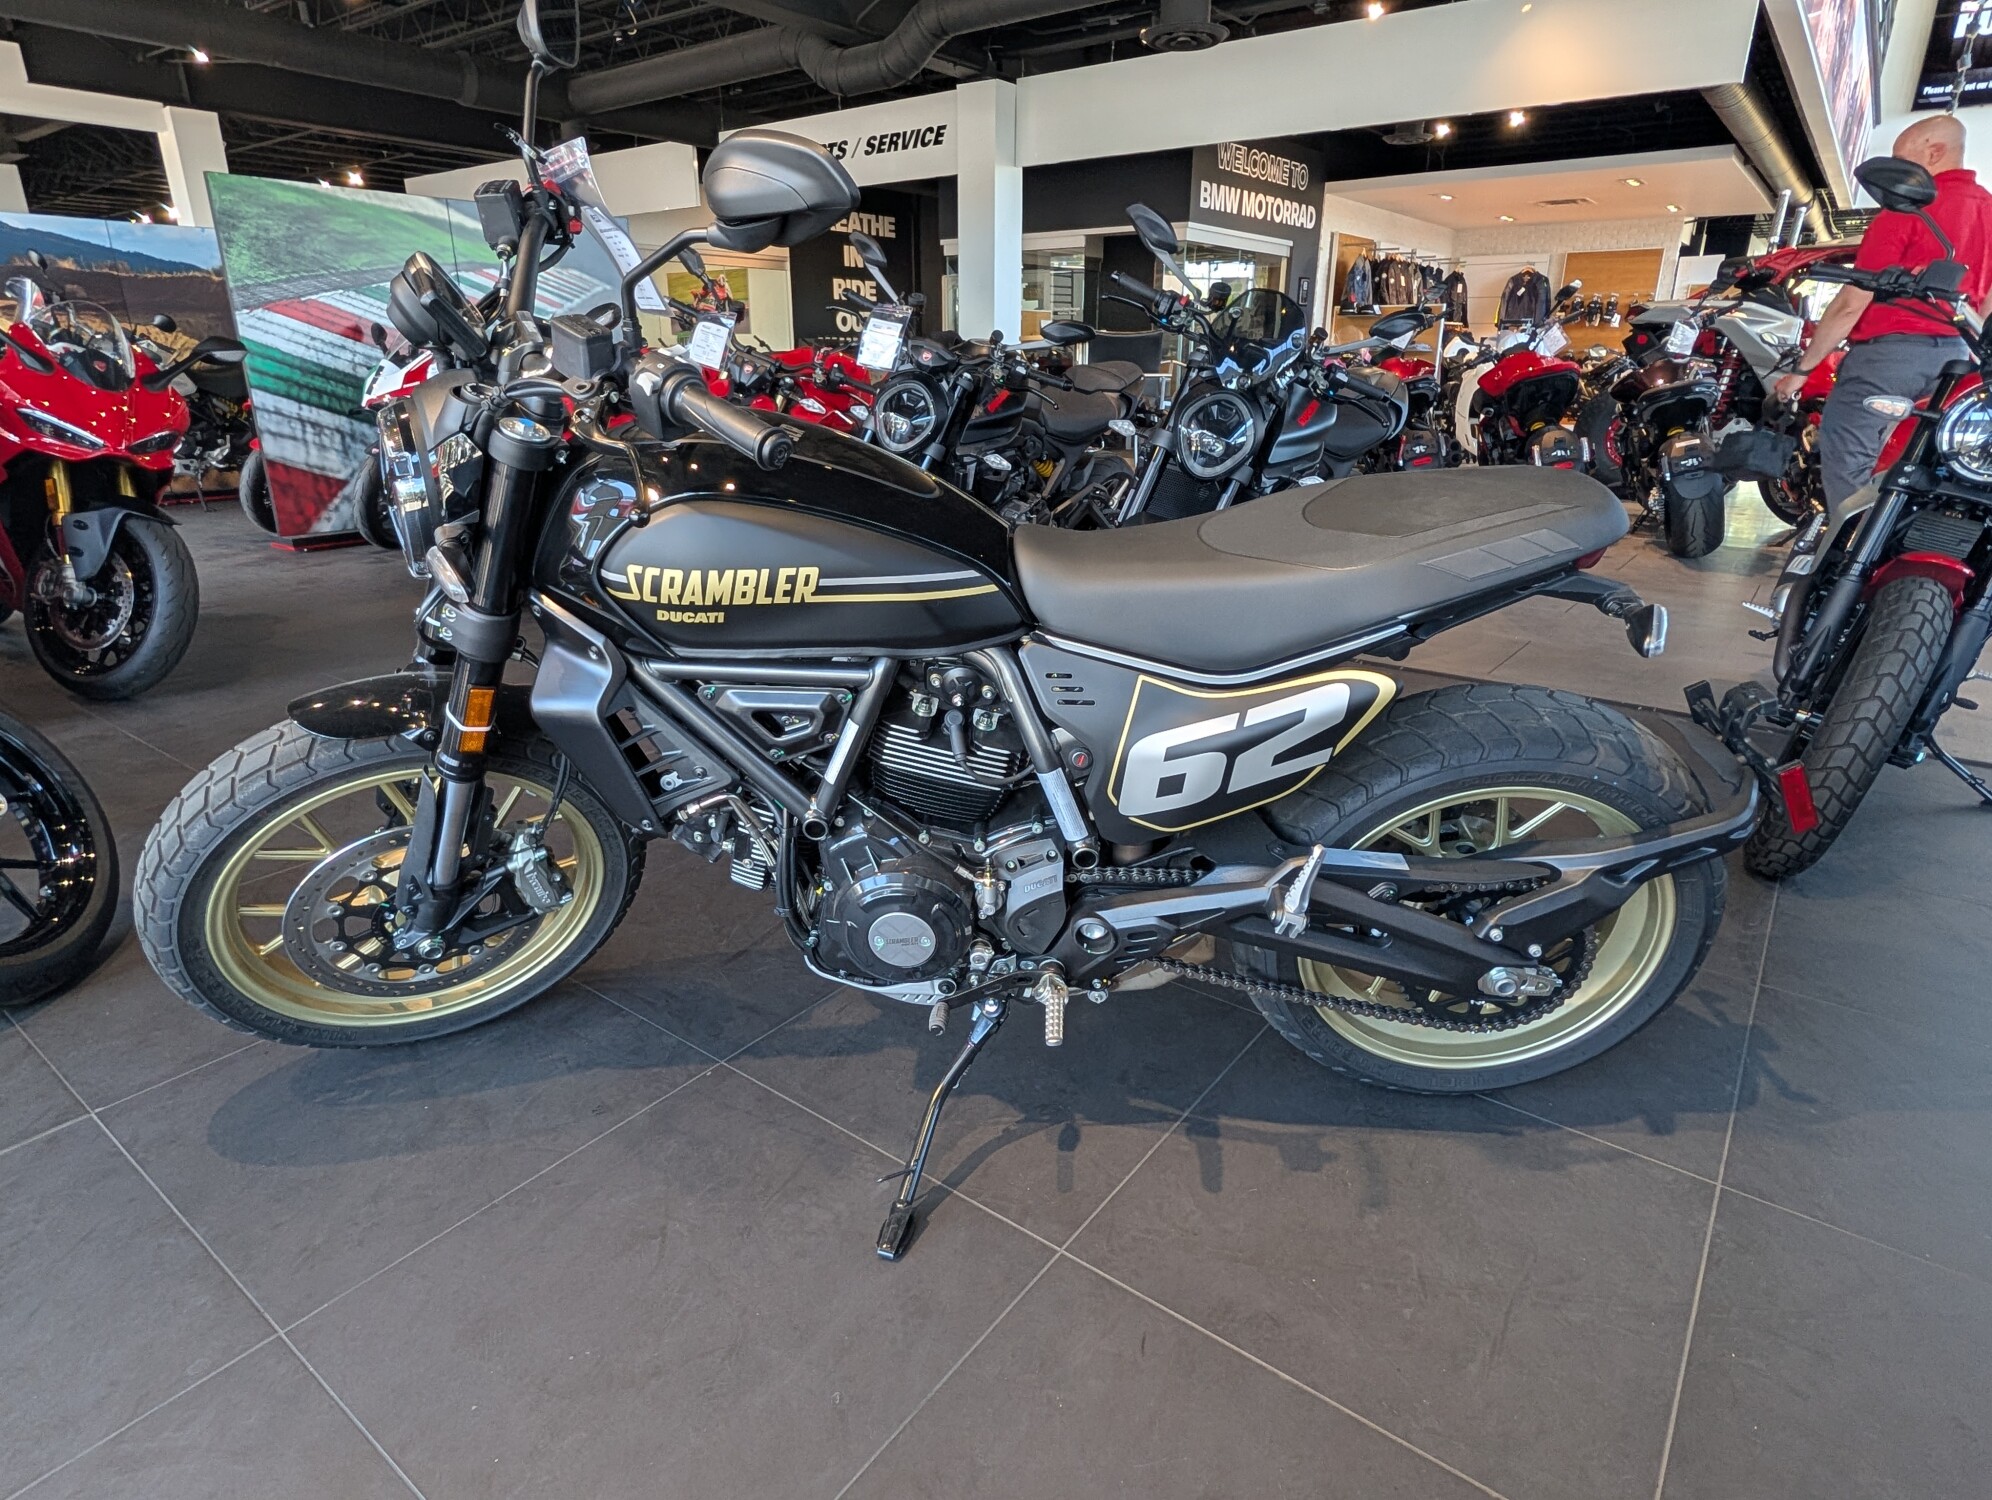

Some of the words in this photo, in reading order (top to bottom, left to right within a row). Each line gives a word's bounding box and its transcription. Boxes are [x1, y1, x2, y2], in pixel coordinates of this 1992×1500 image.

[864, 124, 947, 156] SERVICE
[1217, 142, 1291, 186] WELCOME
[1291, 160, 1309, 191] TO
[1200, 180, 1241, 215] BMW
[1241, 189, 1317, 229] MOTORRAD
[831, 211, 896, 238] EATHE
[836, 311, 871, 333] OU
[612, 564, 820, 606] SCRAMBLER
[656, 609, 725, 624] DUCATI
[1118, 682, 1350, 816] 62
